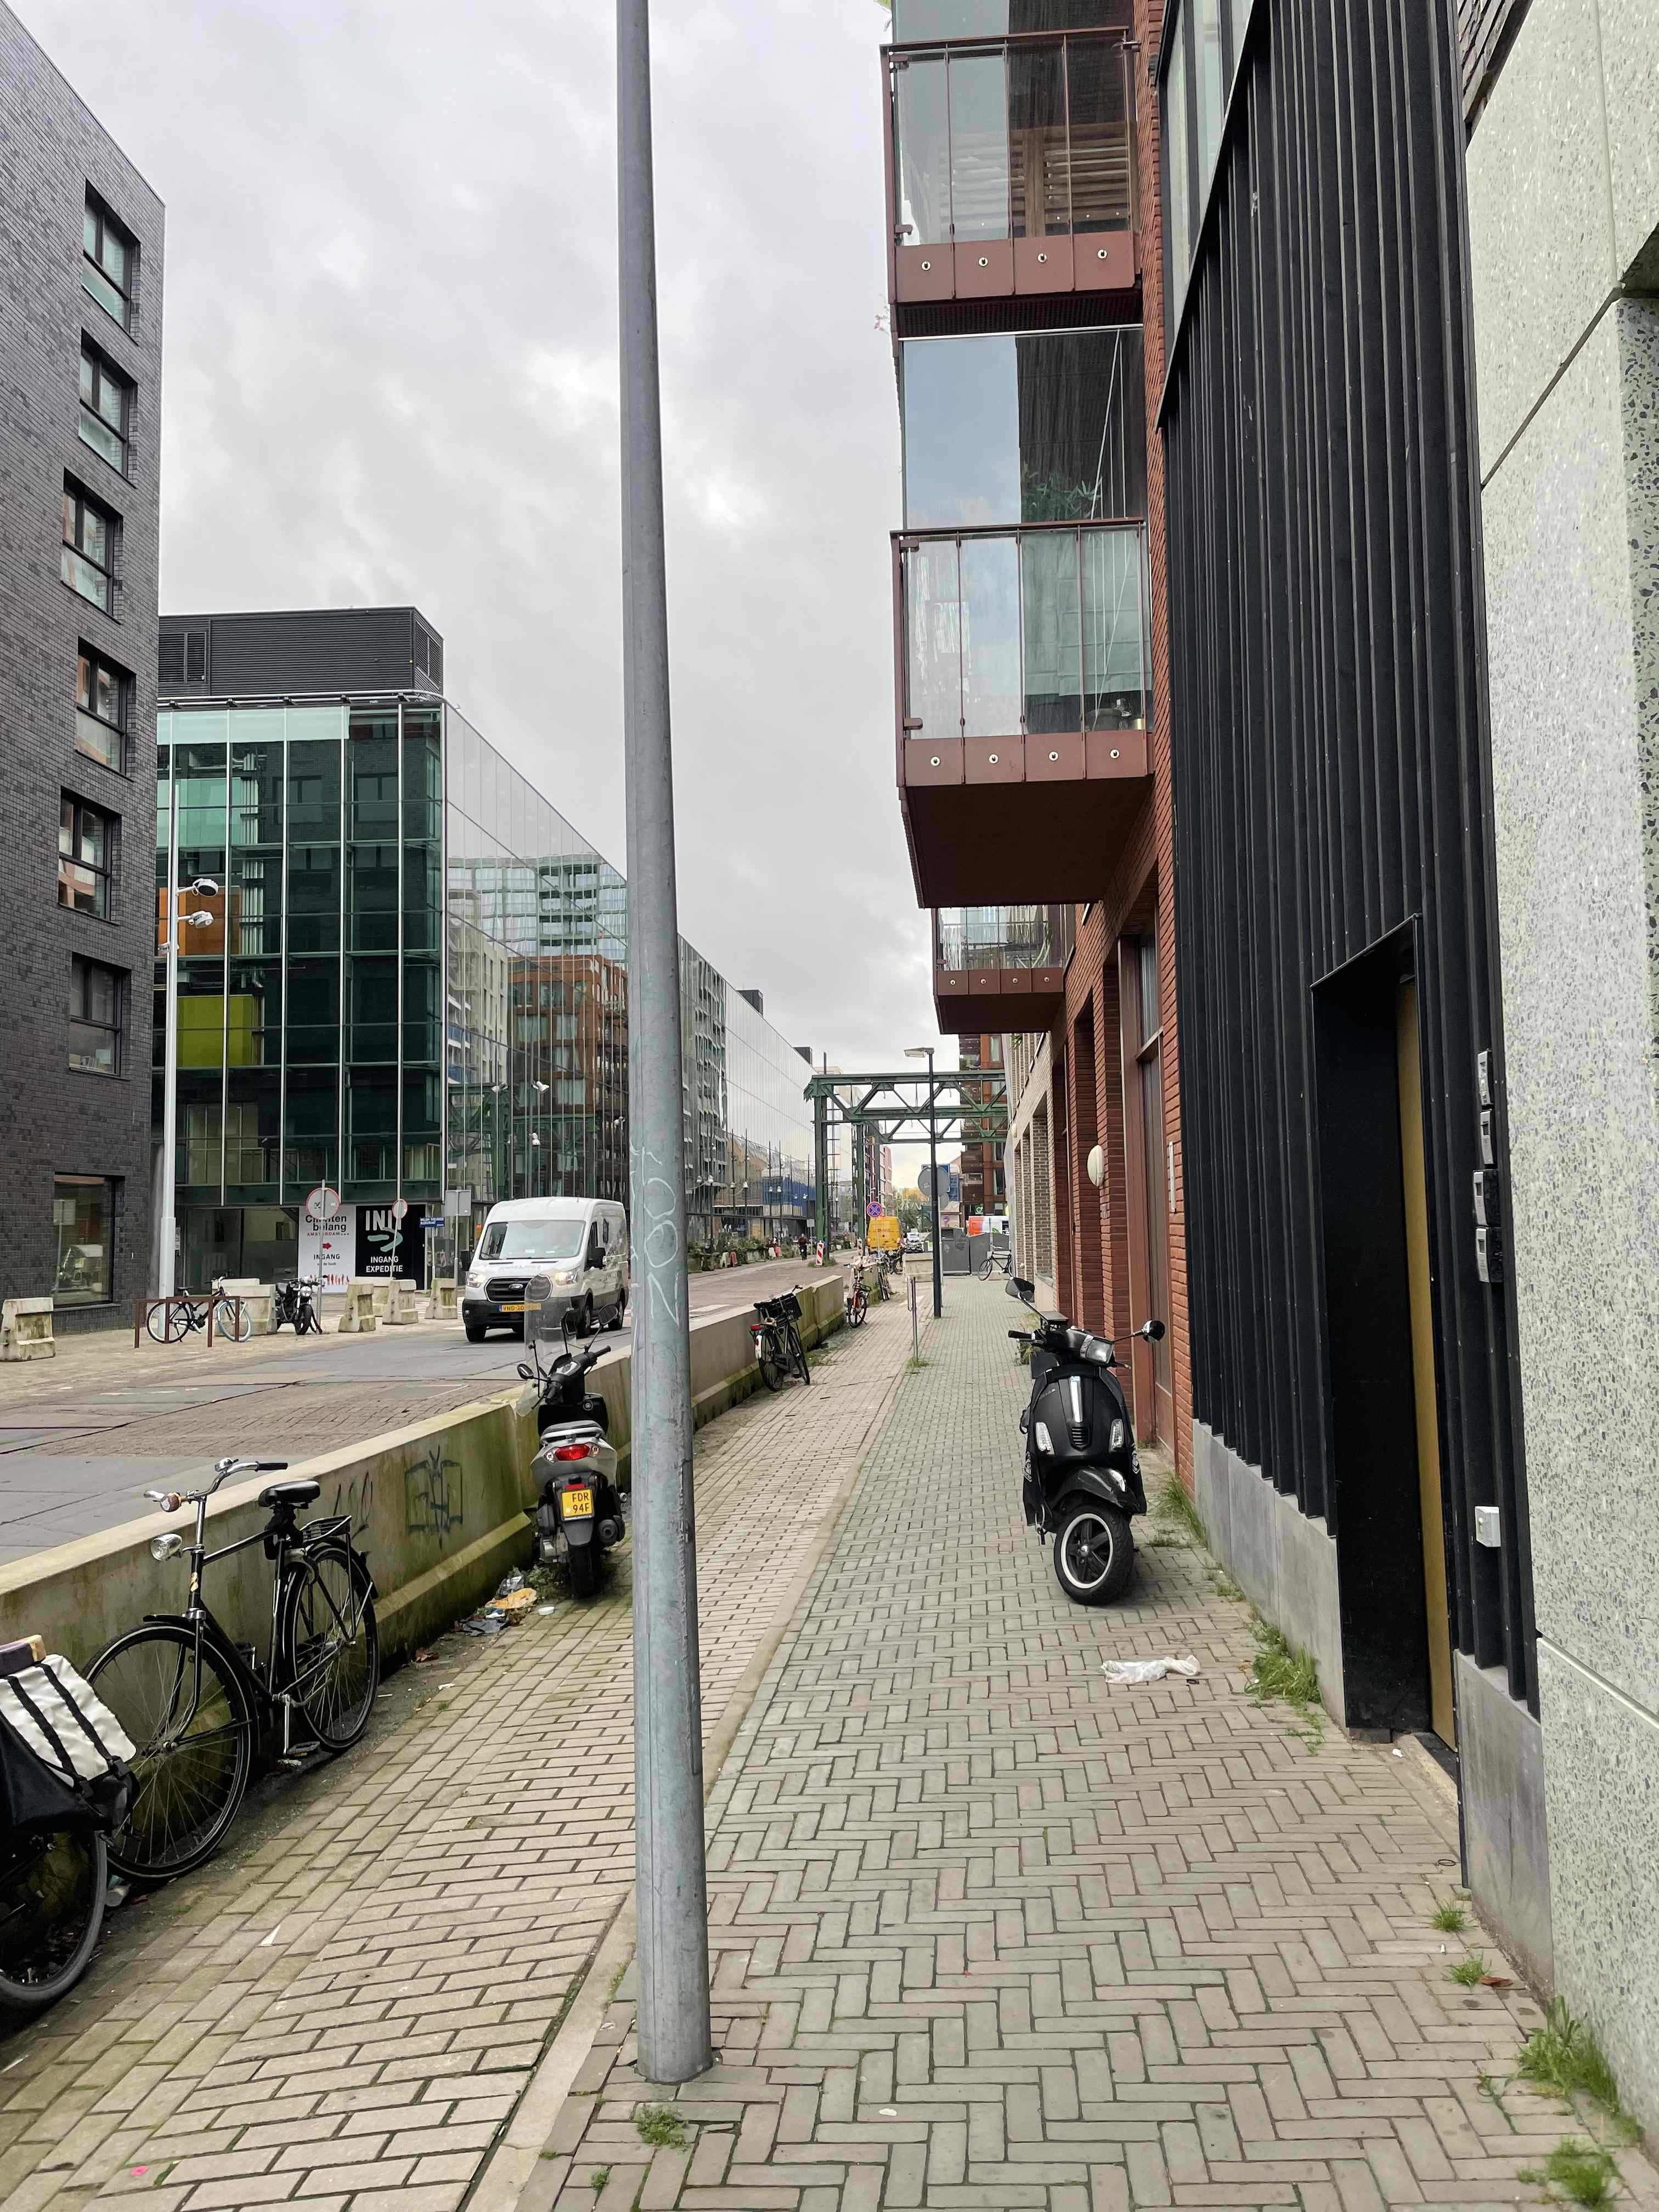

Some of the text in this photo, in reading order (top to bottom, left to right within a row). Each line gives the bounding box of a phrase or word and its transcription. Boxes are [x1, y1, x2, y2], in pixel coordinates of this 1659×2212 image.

[313, 1223, 346, 1232] blang
[572, 1492, 589, 1502] FDR
[573, 1503, 590, 1514] 94F
